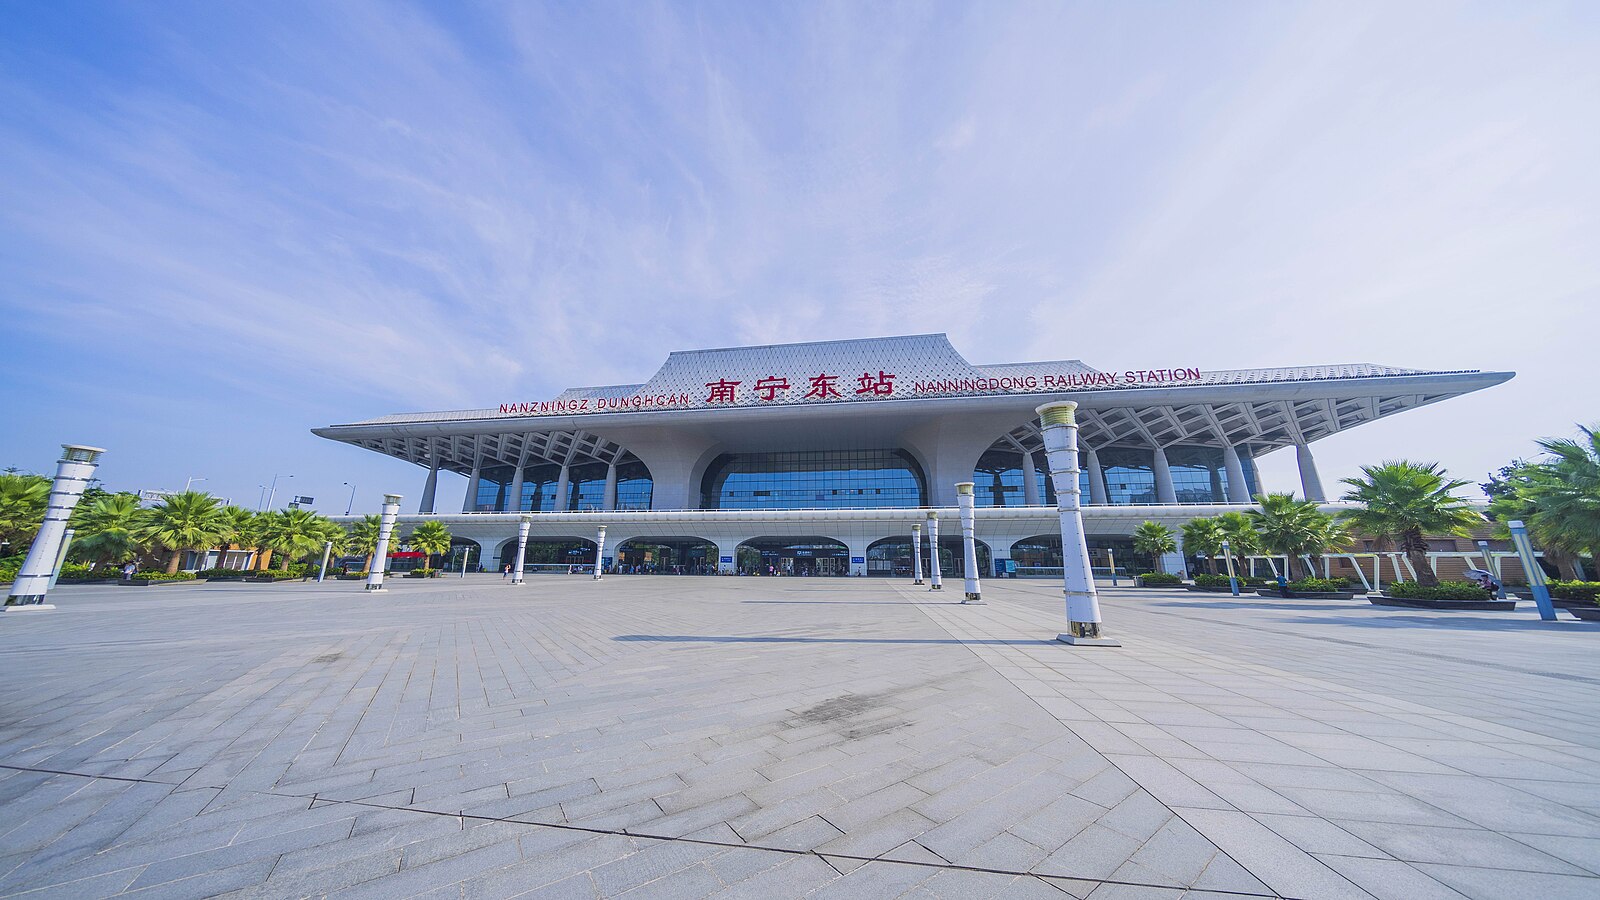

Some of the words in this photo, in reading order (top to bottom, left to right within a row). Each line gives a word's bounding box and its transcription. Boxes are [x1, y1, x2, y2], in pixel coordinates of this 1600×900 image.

[705, 370, 896, 403] 南宁东站
[914, 375, 1038, 394] NANNINGDONG
[1043, 371, 1119, 388] RAILWAY
[1124, 367, 1201, 384] STATION
[499, 399, 589, 413] NANZNINGZ
[598, 393, 690, 409] DUNGHCAN
